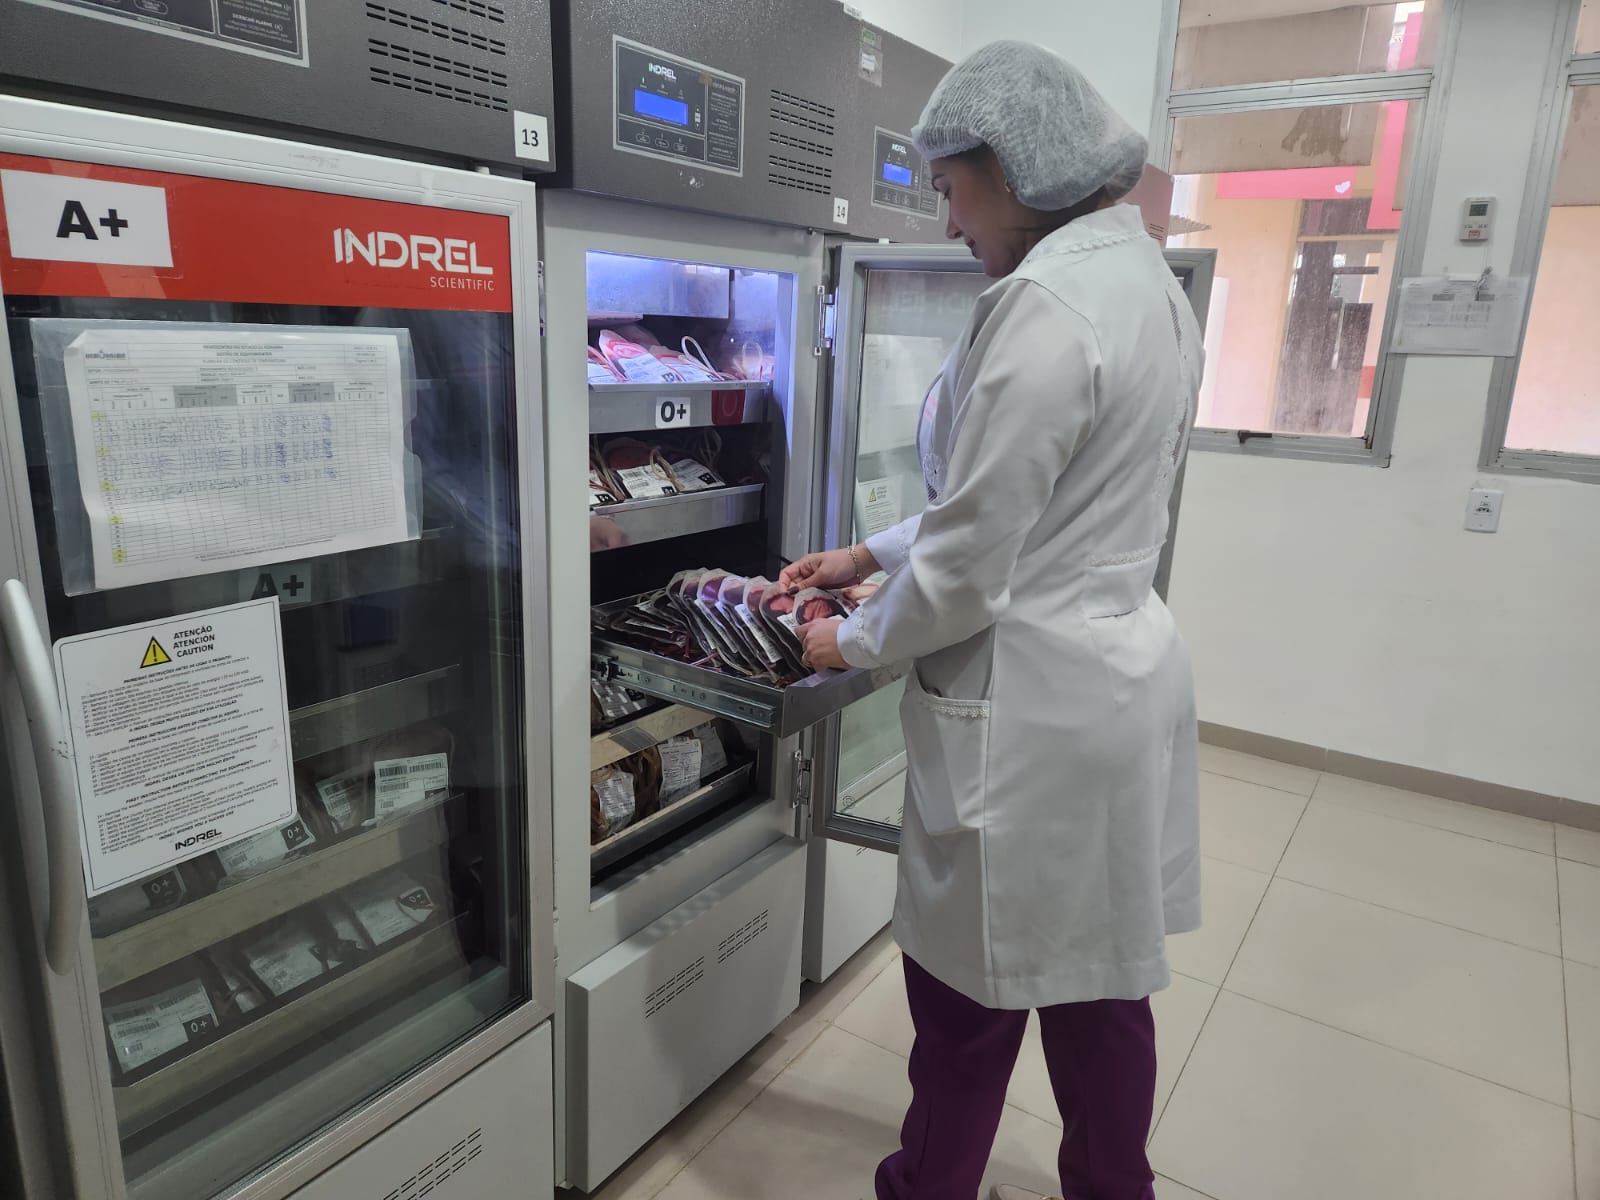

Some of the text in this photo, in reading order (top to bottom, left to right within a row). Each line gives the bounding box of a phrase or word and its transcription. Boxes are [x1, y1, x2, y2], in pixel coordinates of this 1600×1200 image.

[648, 62, 677, 80] INDREL
[521, 128, 538, 147] 13
[56, 199, 129, 241] A+
[836, 204, 847, 220] 14
[333, 227, 494, 275] INDREL
[429, 275, 495, 292] SCIENTIFIC
[251, 571, 304, 599] A+
[173, 624, 213, 641] ATENÇÃO
[176, 643, 214, 659] CAUTION
[175, 828, 223, 852] INDREL
